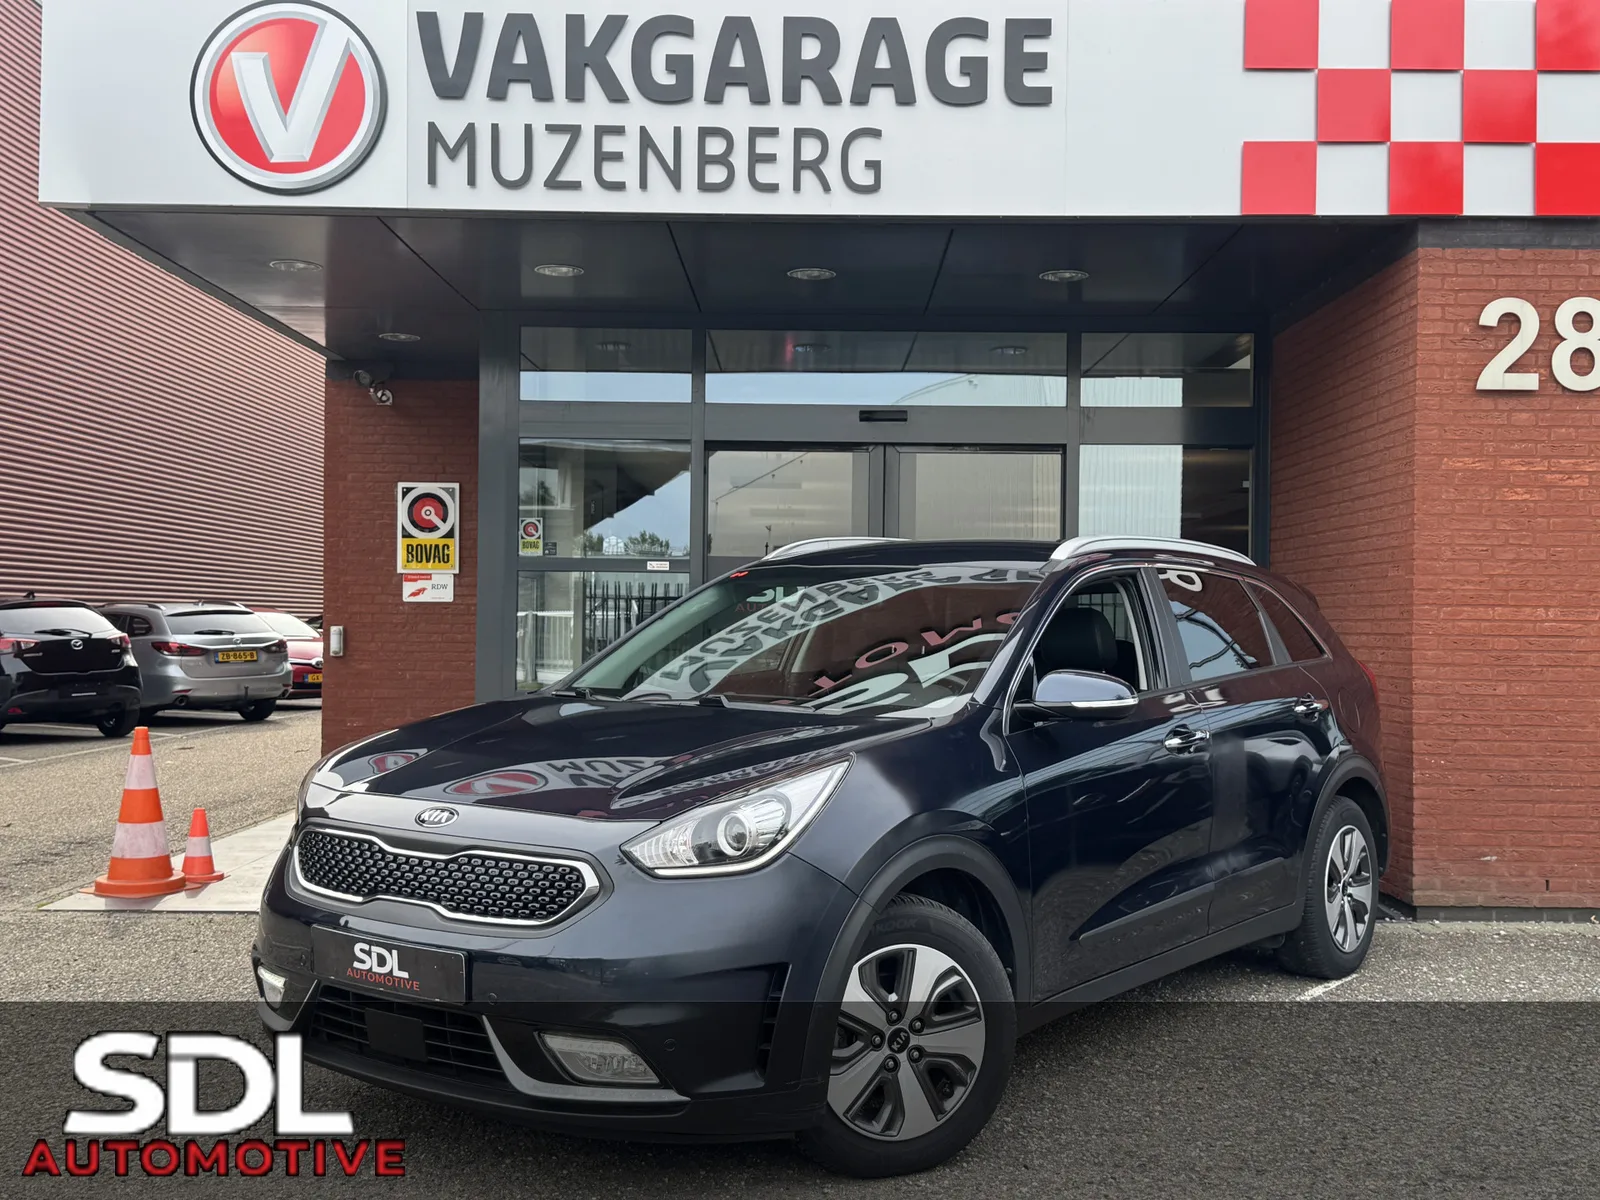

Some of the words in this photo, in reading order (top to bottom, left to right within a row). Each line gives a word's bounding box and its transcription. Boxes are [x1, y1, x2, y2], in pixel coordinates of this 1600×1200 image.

[416, 11, 1053, 107] VAKGARAGE
[427, 121, 883, 194] MUZENBERG
[1476, 297, 1600, 392] 28
[406, 543, 450, 564] BOVAG
[420, 809, 450, 823] KIA
[352, 942, 410, 979] SDL
[346, 967, 420, 991] AUTOMOTIVE
[891, 1031, 908, 1050] KIA
